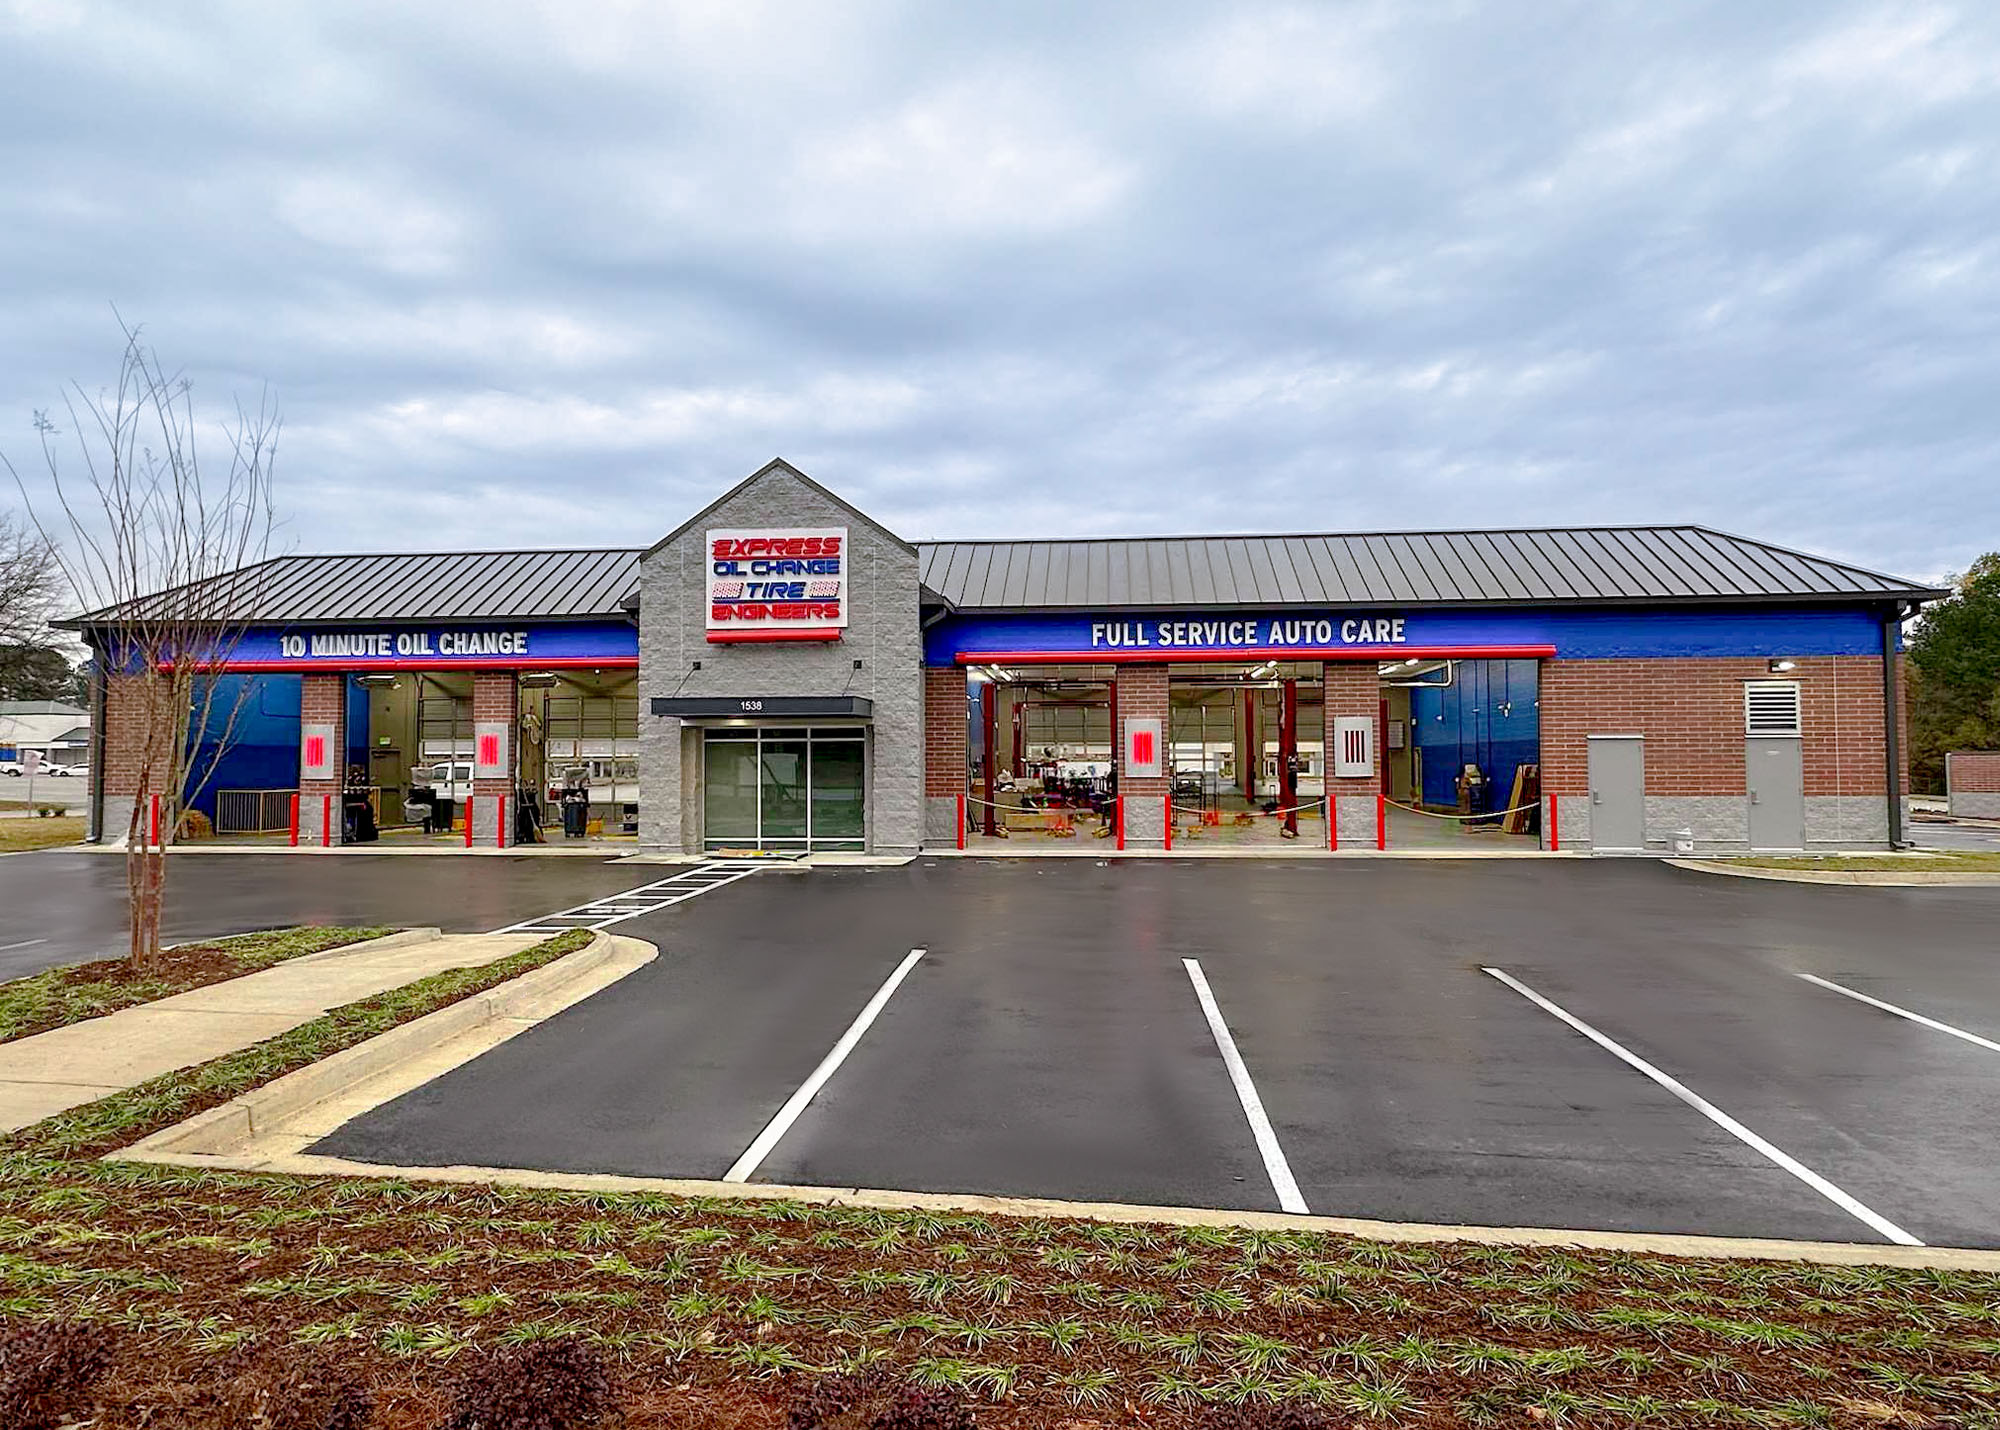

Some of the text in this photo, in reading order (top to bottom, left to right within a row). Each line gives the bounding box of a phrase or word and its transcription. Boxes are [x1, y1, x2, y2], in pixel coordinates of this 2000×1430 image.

[712, 537, 842, 556] EXPRESS
[713, 559, 841, 576] OIL CHANGE
[746, 581, 807, 599] TIRE
[711, 603, 840, 620] ENGINEERS
[1091, 618, 1406, 647] FULL SERVICE AUTO CARE
[280, 632, 528, 657] 10 MINUTE OIL CHANGE
[740, 700, 762, 711] 1538
